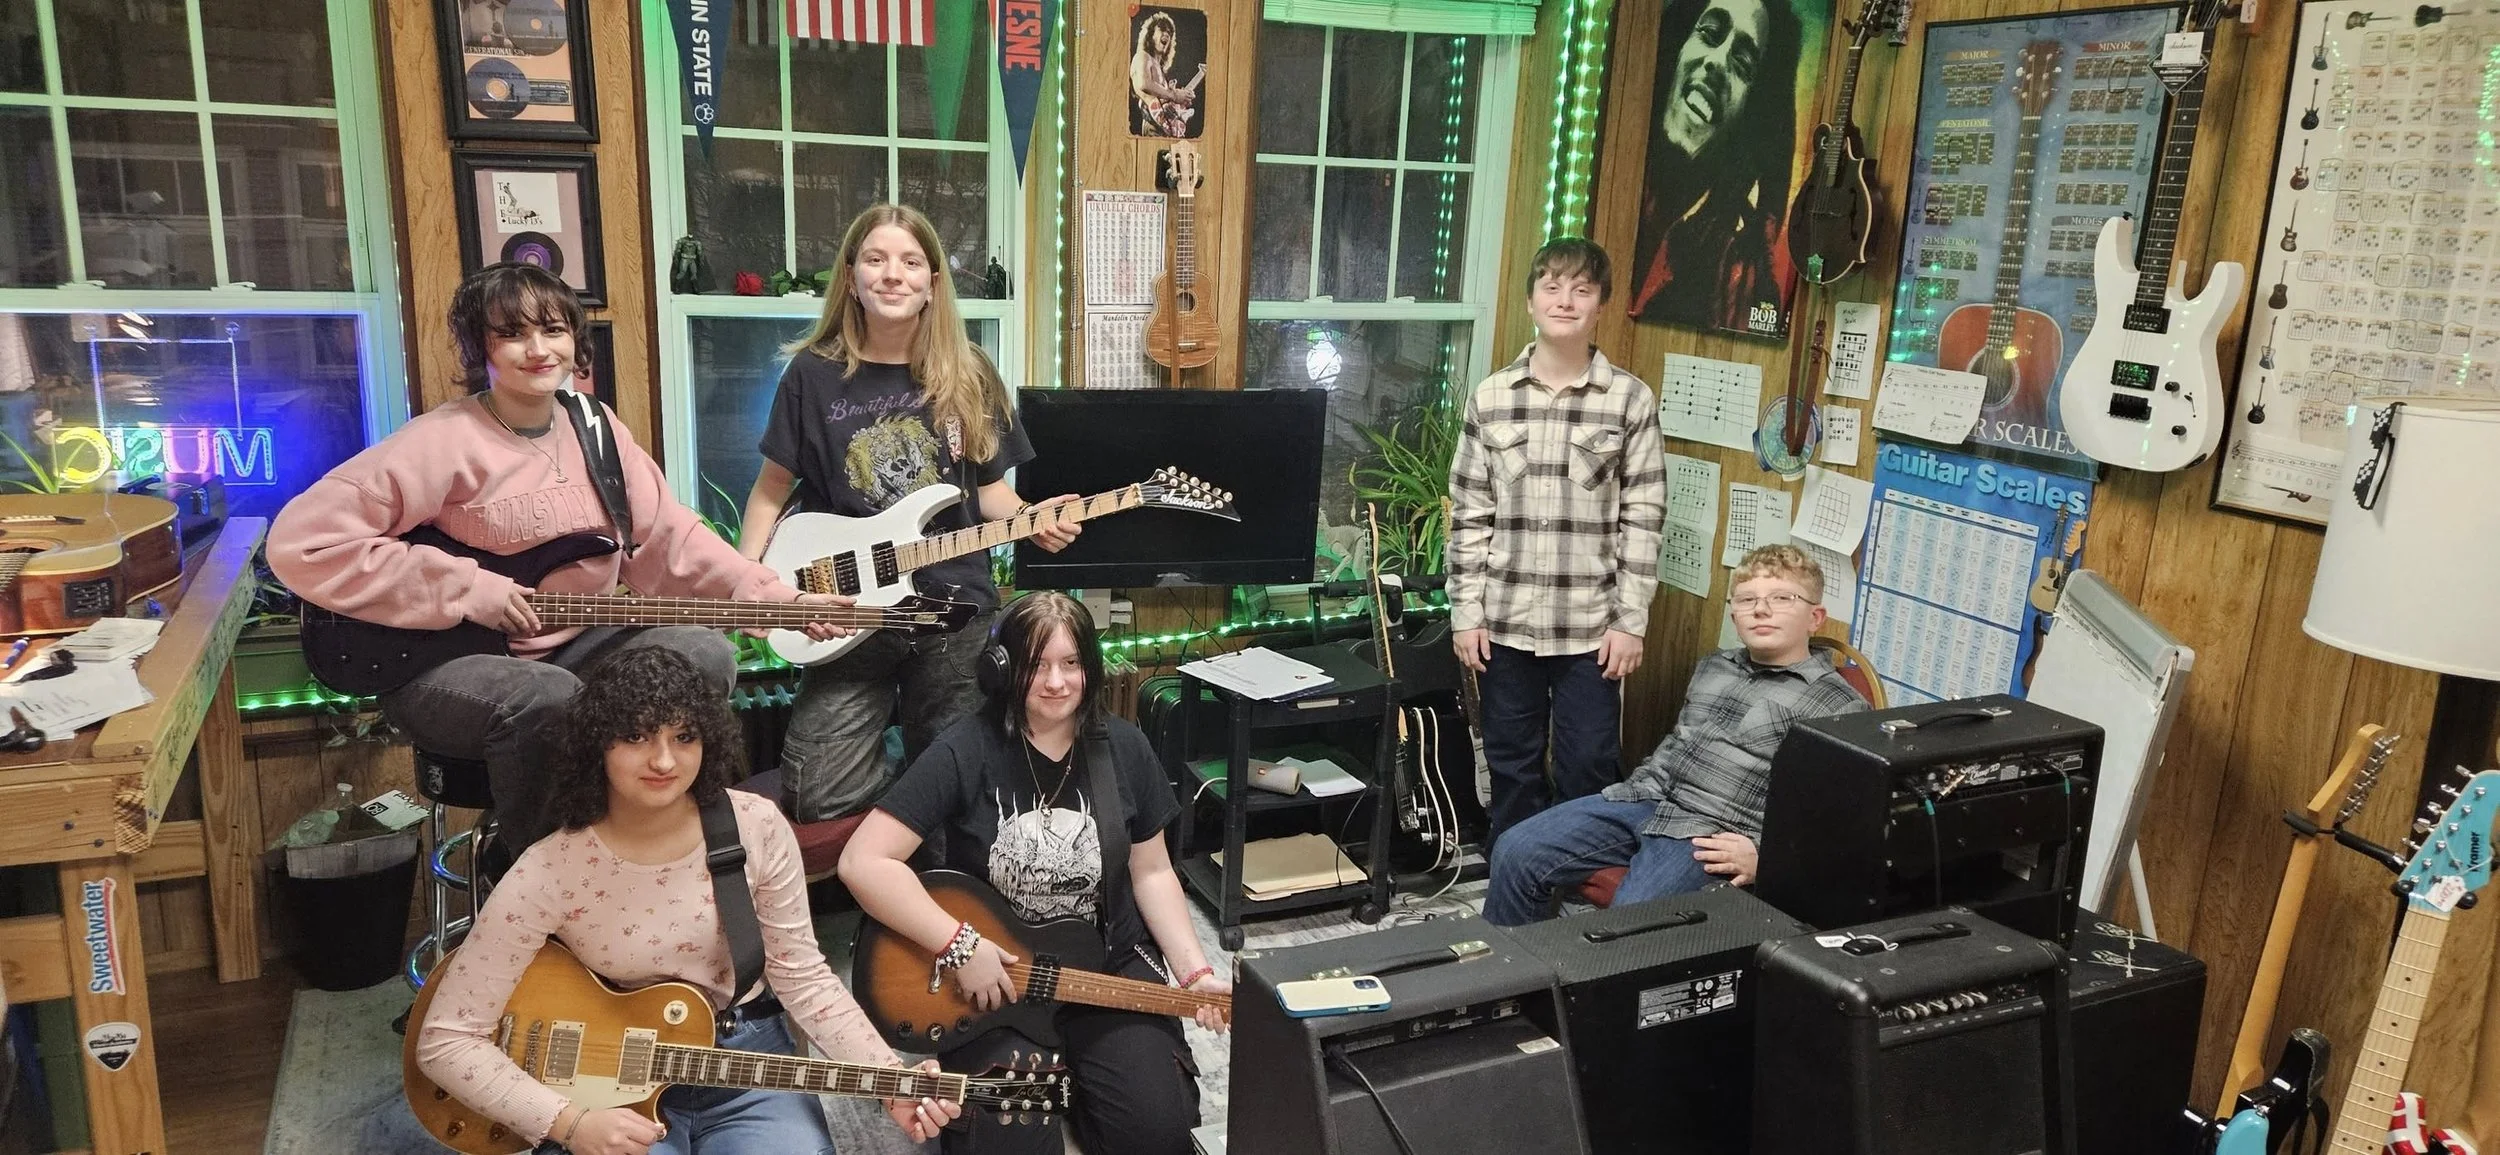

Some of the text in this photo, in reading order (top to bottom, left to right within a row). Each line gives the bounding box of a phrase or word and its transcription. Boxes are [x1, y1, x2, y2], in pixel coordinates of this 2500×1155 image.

[1006, 0, 1041, 72] ESNE
[2098, 41, 2131, 52] MINOR
[692, 28, 712, 96] STATE
[1961, 50, 1989, 60] MAJOR
[1089, 203, 1161, 213] UKULELE CHORDS
[508, 217, 528, 225] Lucky
[2071, 216, 2104, 226] MODES
[1102, 314, 1129, 322] Mandolin
[1748, 320, 1776, 333] MARLEY
[1749, 306, 1777, 325] BOB
[825, 392, 910, 424] Beautiful
[1993, 420, 2078, 455] SCALES
[1880, 444, 1970, 487] Guitar
[1976, 463, 2087, 516] Scales
[1160, 488, 1215, 510] Jackson
[450, 484, 607, 548] PENNSYLV
[2467, 831, 2481, 873] Kramer
[90, 881, 115, 993] Sweetwater
